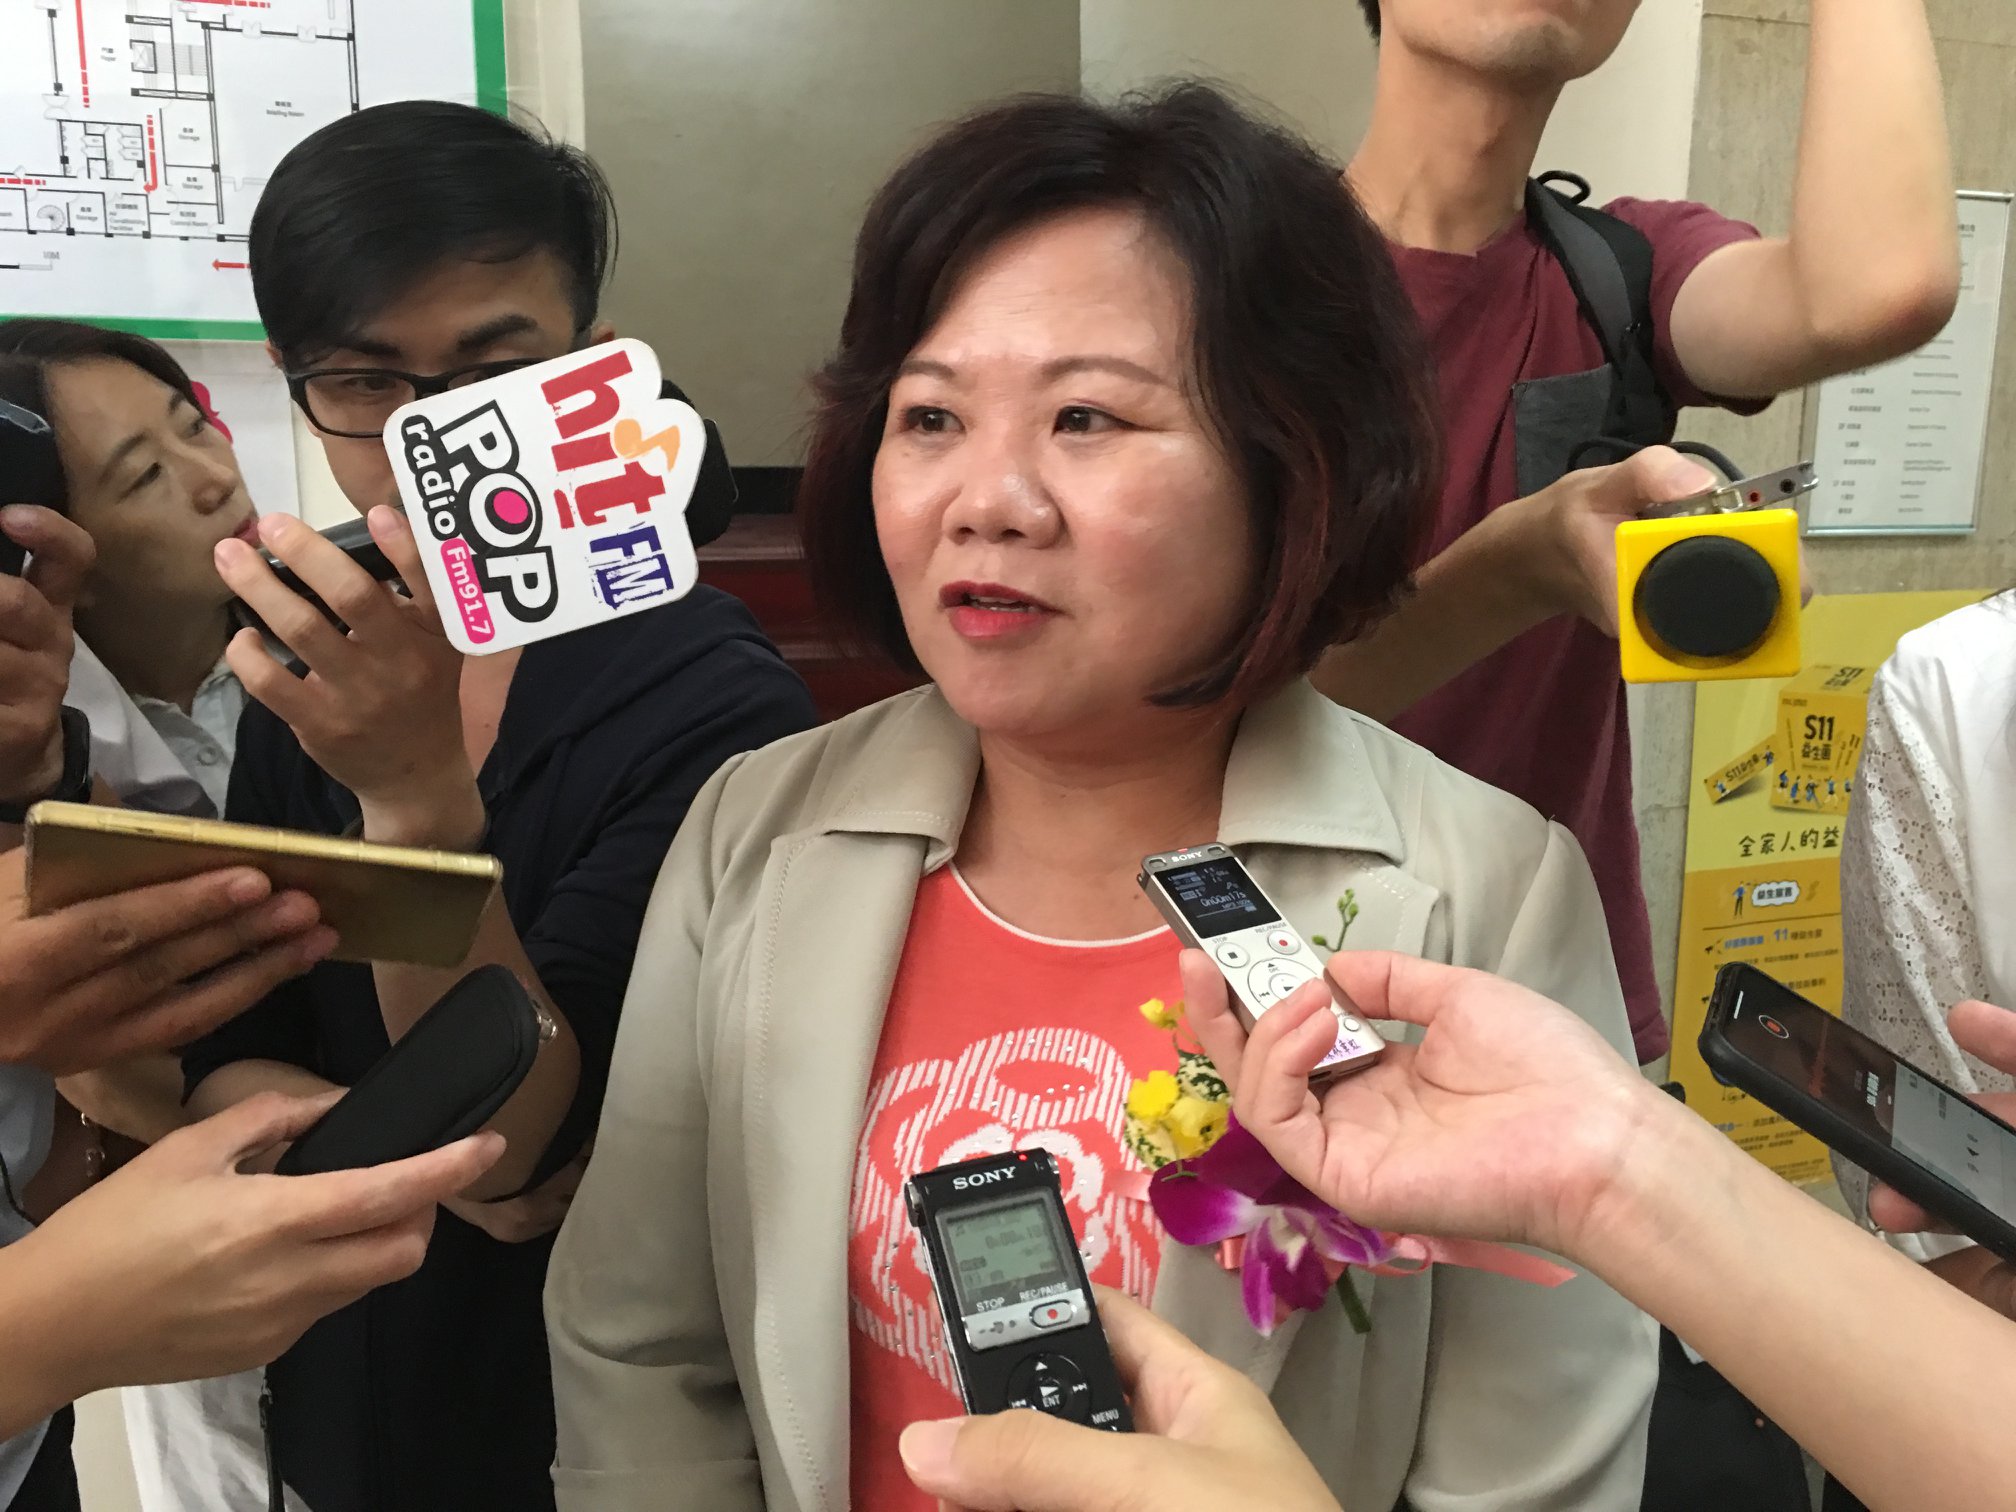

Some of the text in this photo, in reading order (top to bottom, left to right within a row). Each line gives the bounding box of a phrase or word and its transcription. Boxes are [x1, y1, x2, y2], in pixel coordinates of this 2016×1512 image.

[541, 350, 680, 610] hit FM
[433, 399, 559, 623] POP
[401, 414, 491, 636] radio Fm91.7
[1834, 667, 1865, 678] S11
[1803, 714, 1835, 742] S11
[1801, 742, 1832, 761] 益生菌
[1738, 825, 1839, 858] 全家人的益
[1171, 851, 1202, 863] SONY
[952, 1166, 1017, 1190] SONY
[1019, 1282, 1068, 1301] REC/PAUSE
[976, 1296, 1005, 1313] STOP
[1042, 1394, 1061, 1408] ENT
[1091, 1409, 1120, 1425] MENU
